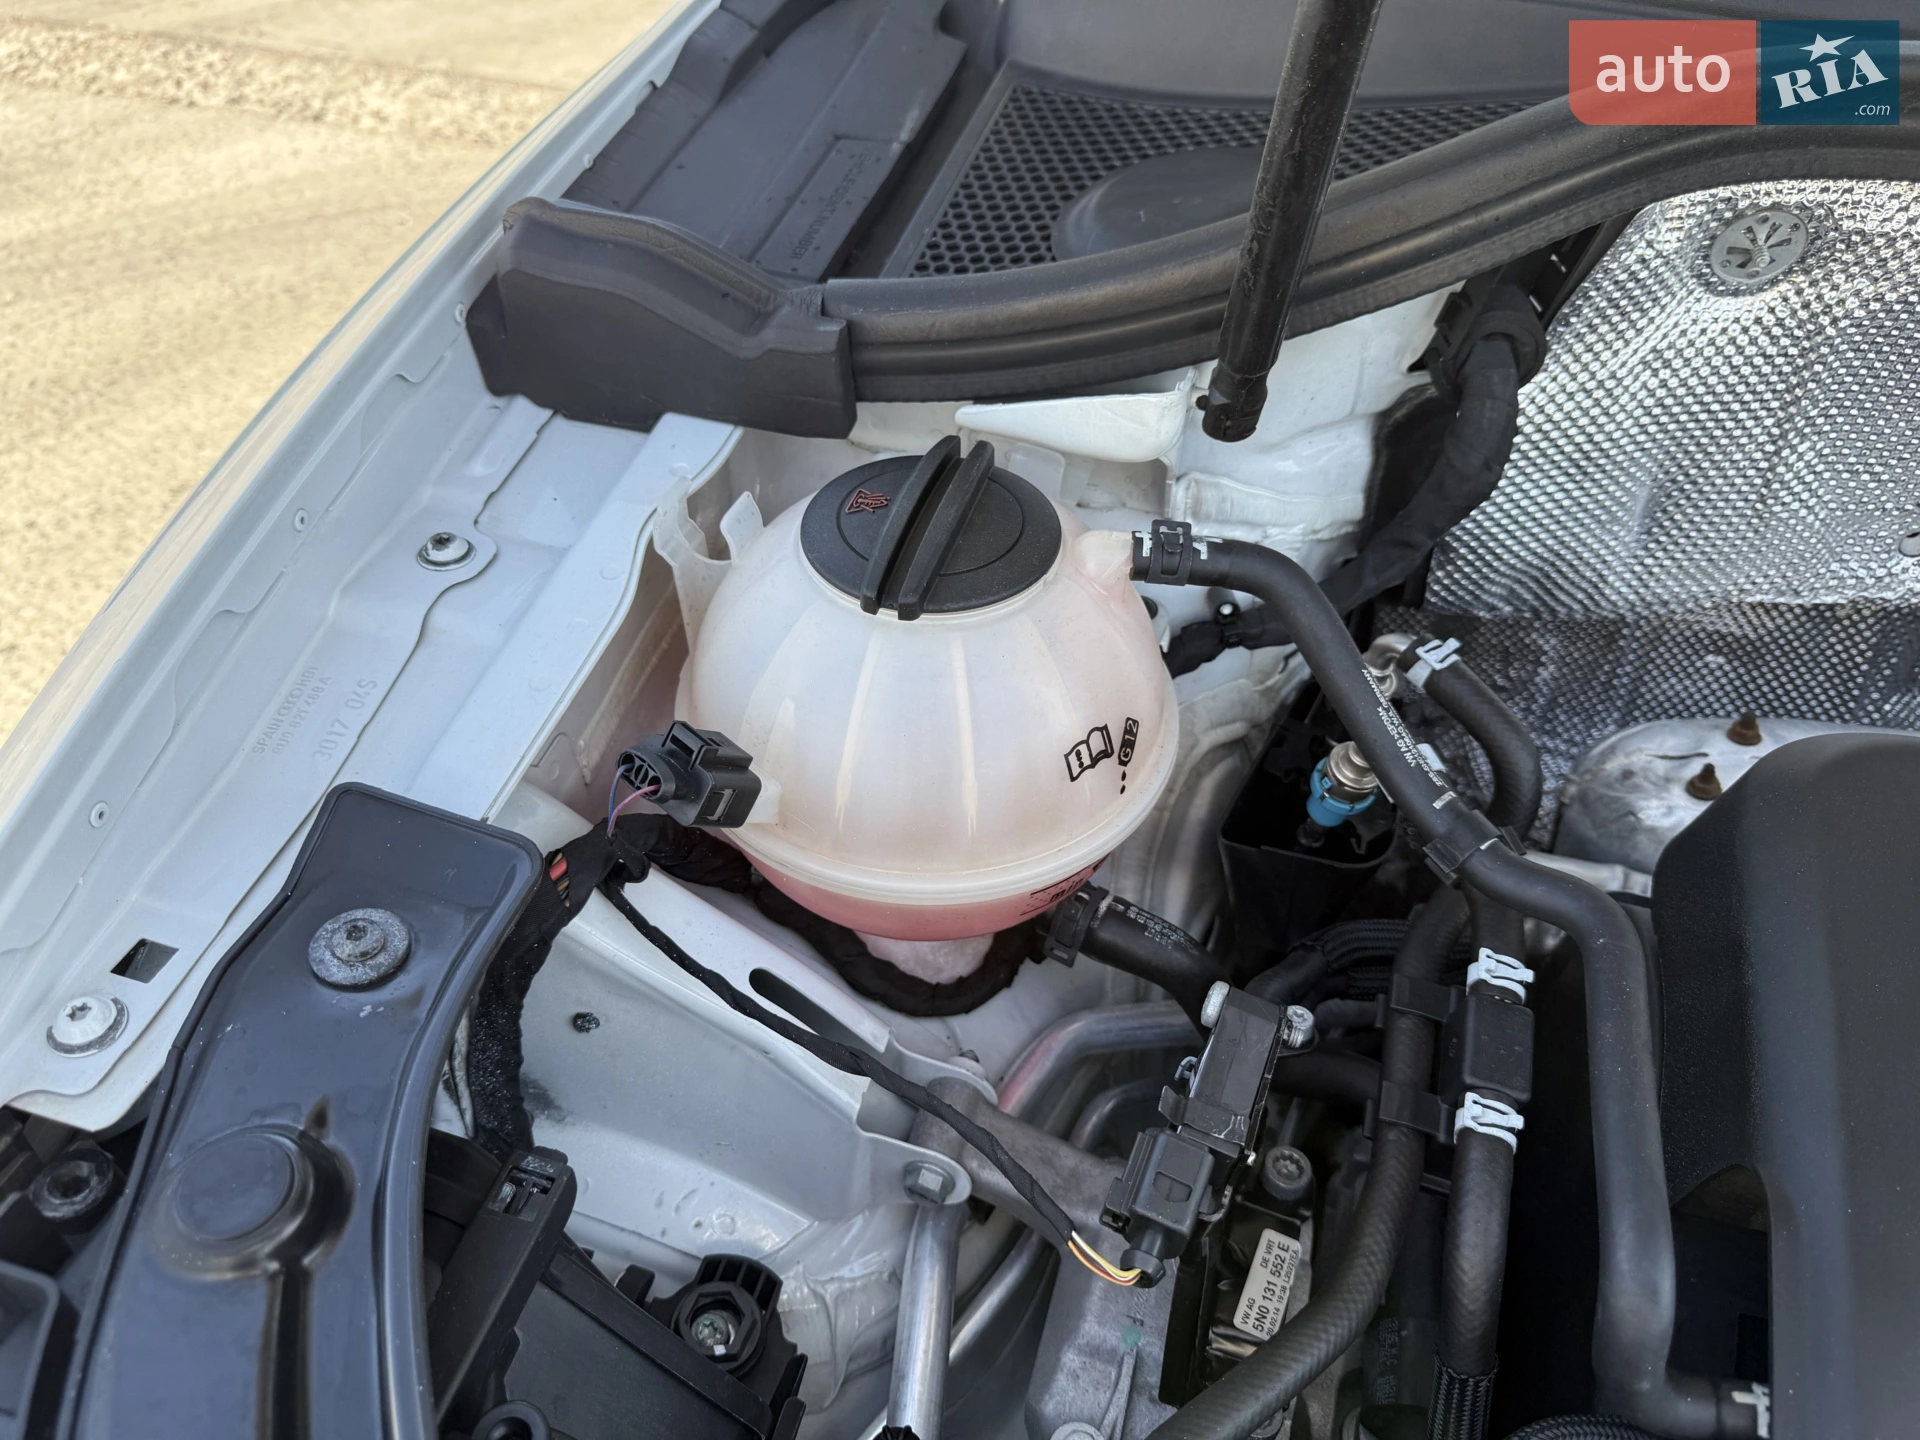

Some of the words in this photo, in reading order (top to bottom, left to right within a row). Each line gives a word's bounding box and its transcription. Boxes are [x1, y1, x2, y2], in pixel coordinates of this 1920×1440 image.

[1361, 669, 1388, 709] GERMANY
[252, 717, 285, 754] SPAIN
[312, 718, 350, 762] 3017
[1396, 738, 1408, 753] AG
[1403, 752, 1417, 768] VW
[1264, 1238, 1276, 1255] VRT
[1277, 1241, 1290, 1252] E
[1260, 1256, 1270, 1269] DE
[1270, 1254, 1286, 1278] 552
[1262, 1280, 1277, 1303] 131
[1240, 1310, 1251, 1325] VW
[1247, 1297, 1256, 1311] AG
[1252, 1304, 1270, 1332] 5N0
